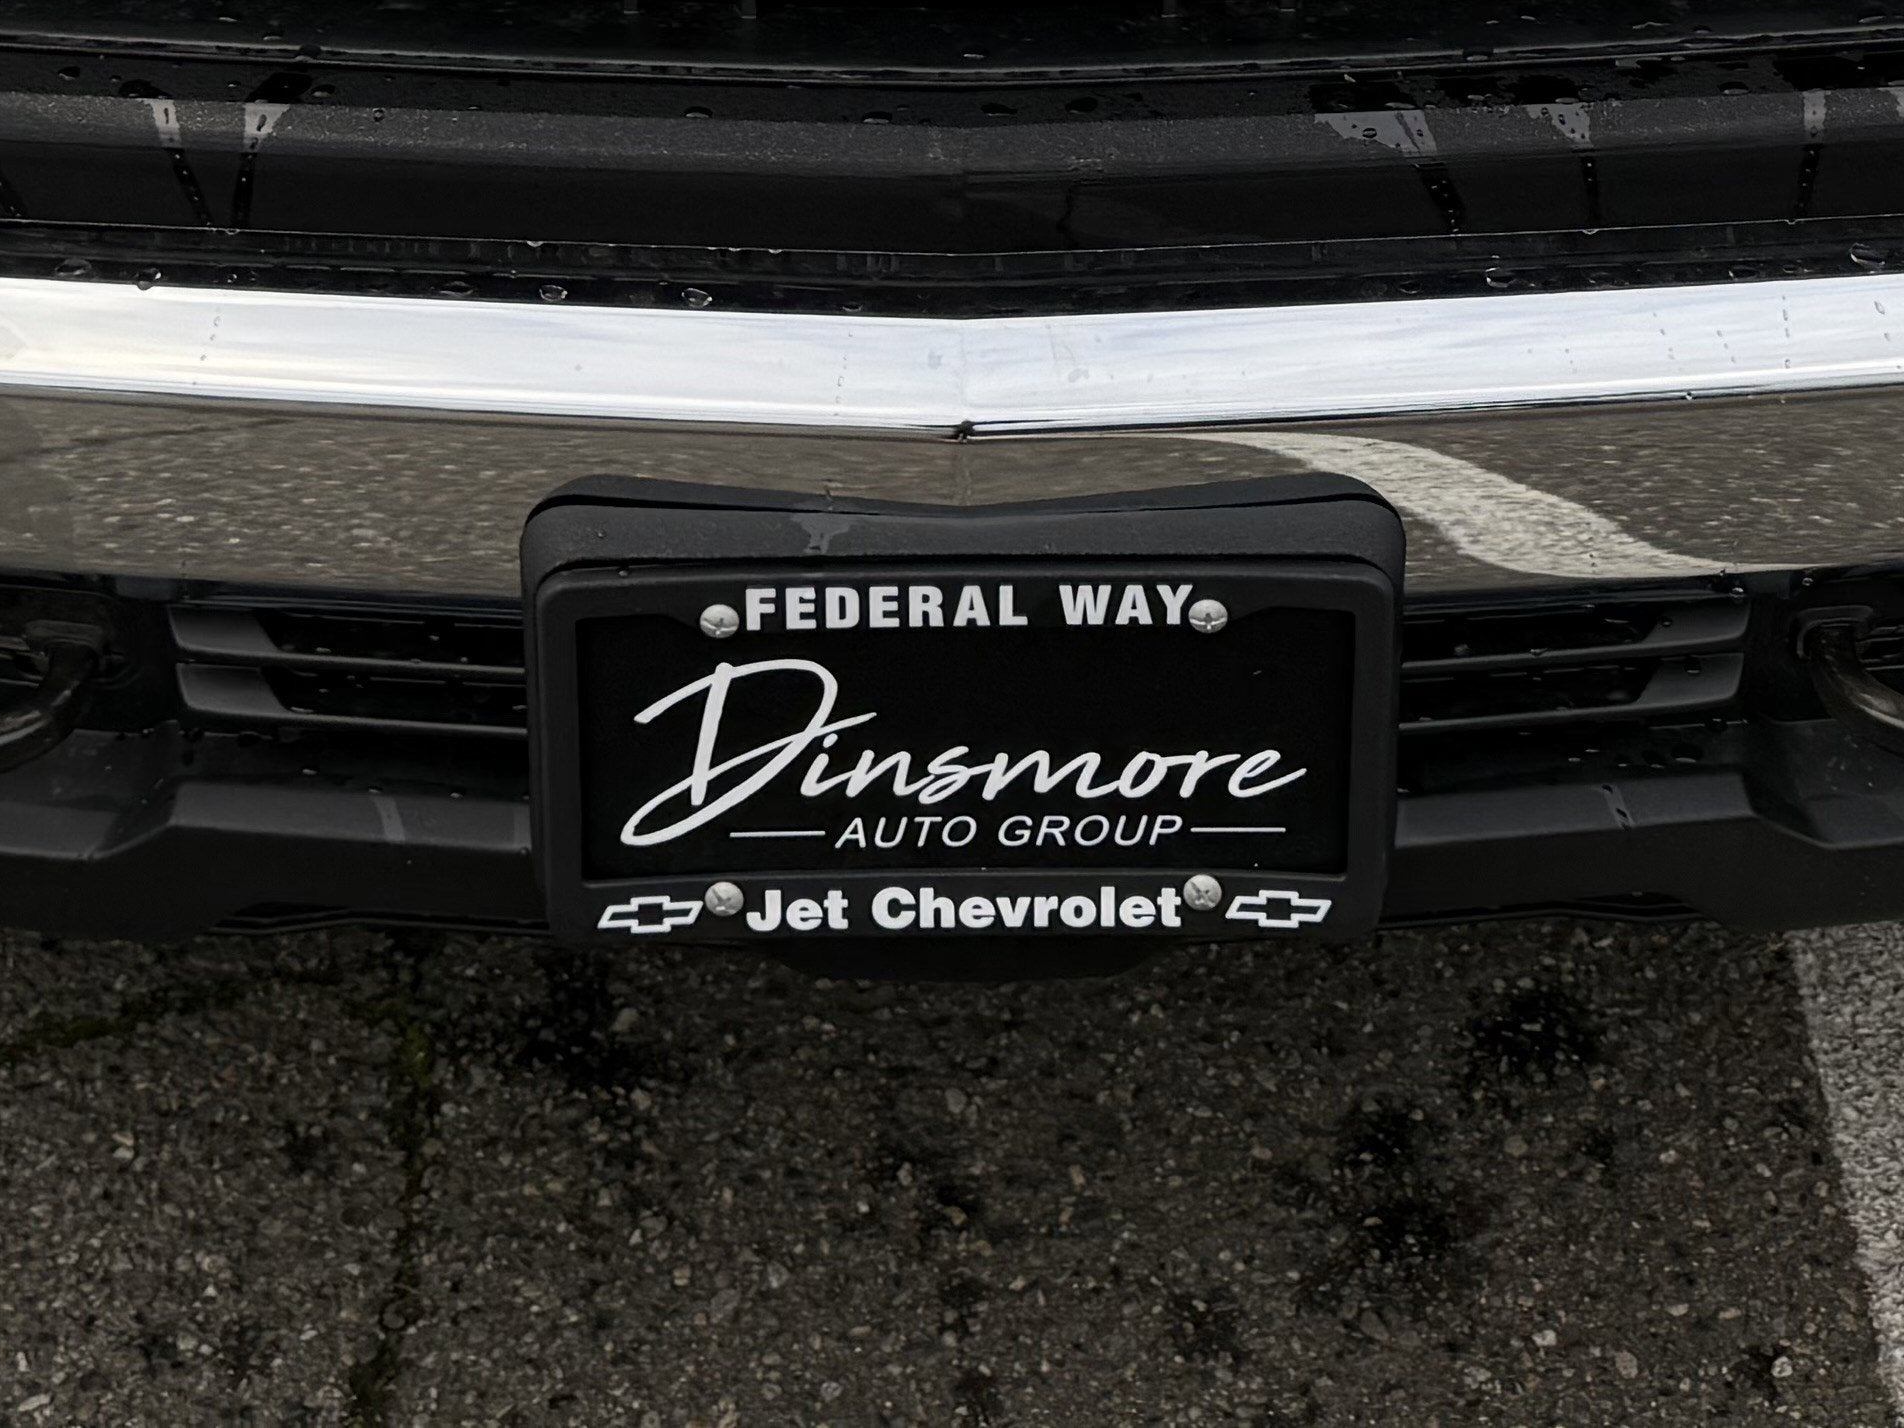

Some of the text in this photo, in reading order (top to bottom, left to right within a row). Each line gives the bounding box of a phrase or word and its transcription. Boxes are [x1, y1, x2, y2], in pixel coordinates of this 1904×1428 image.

[746, 584, 1193, 631] FEDERAL WAY
[620, 658, 1307, 846] Dinsmore
[835, 815, 1183, 848] AUTO GROUP
[747, 884, 1182, 932] Jet Chevrolet
